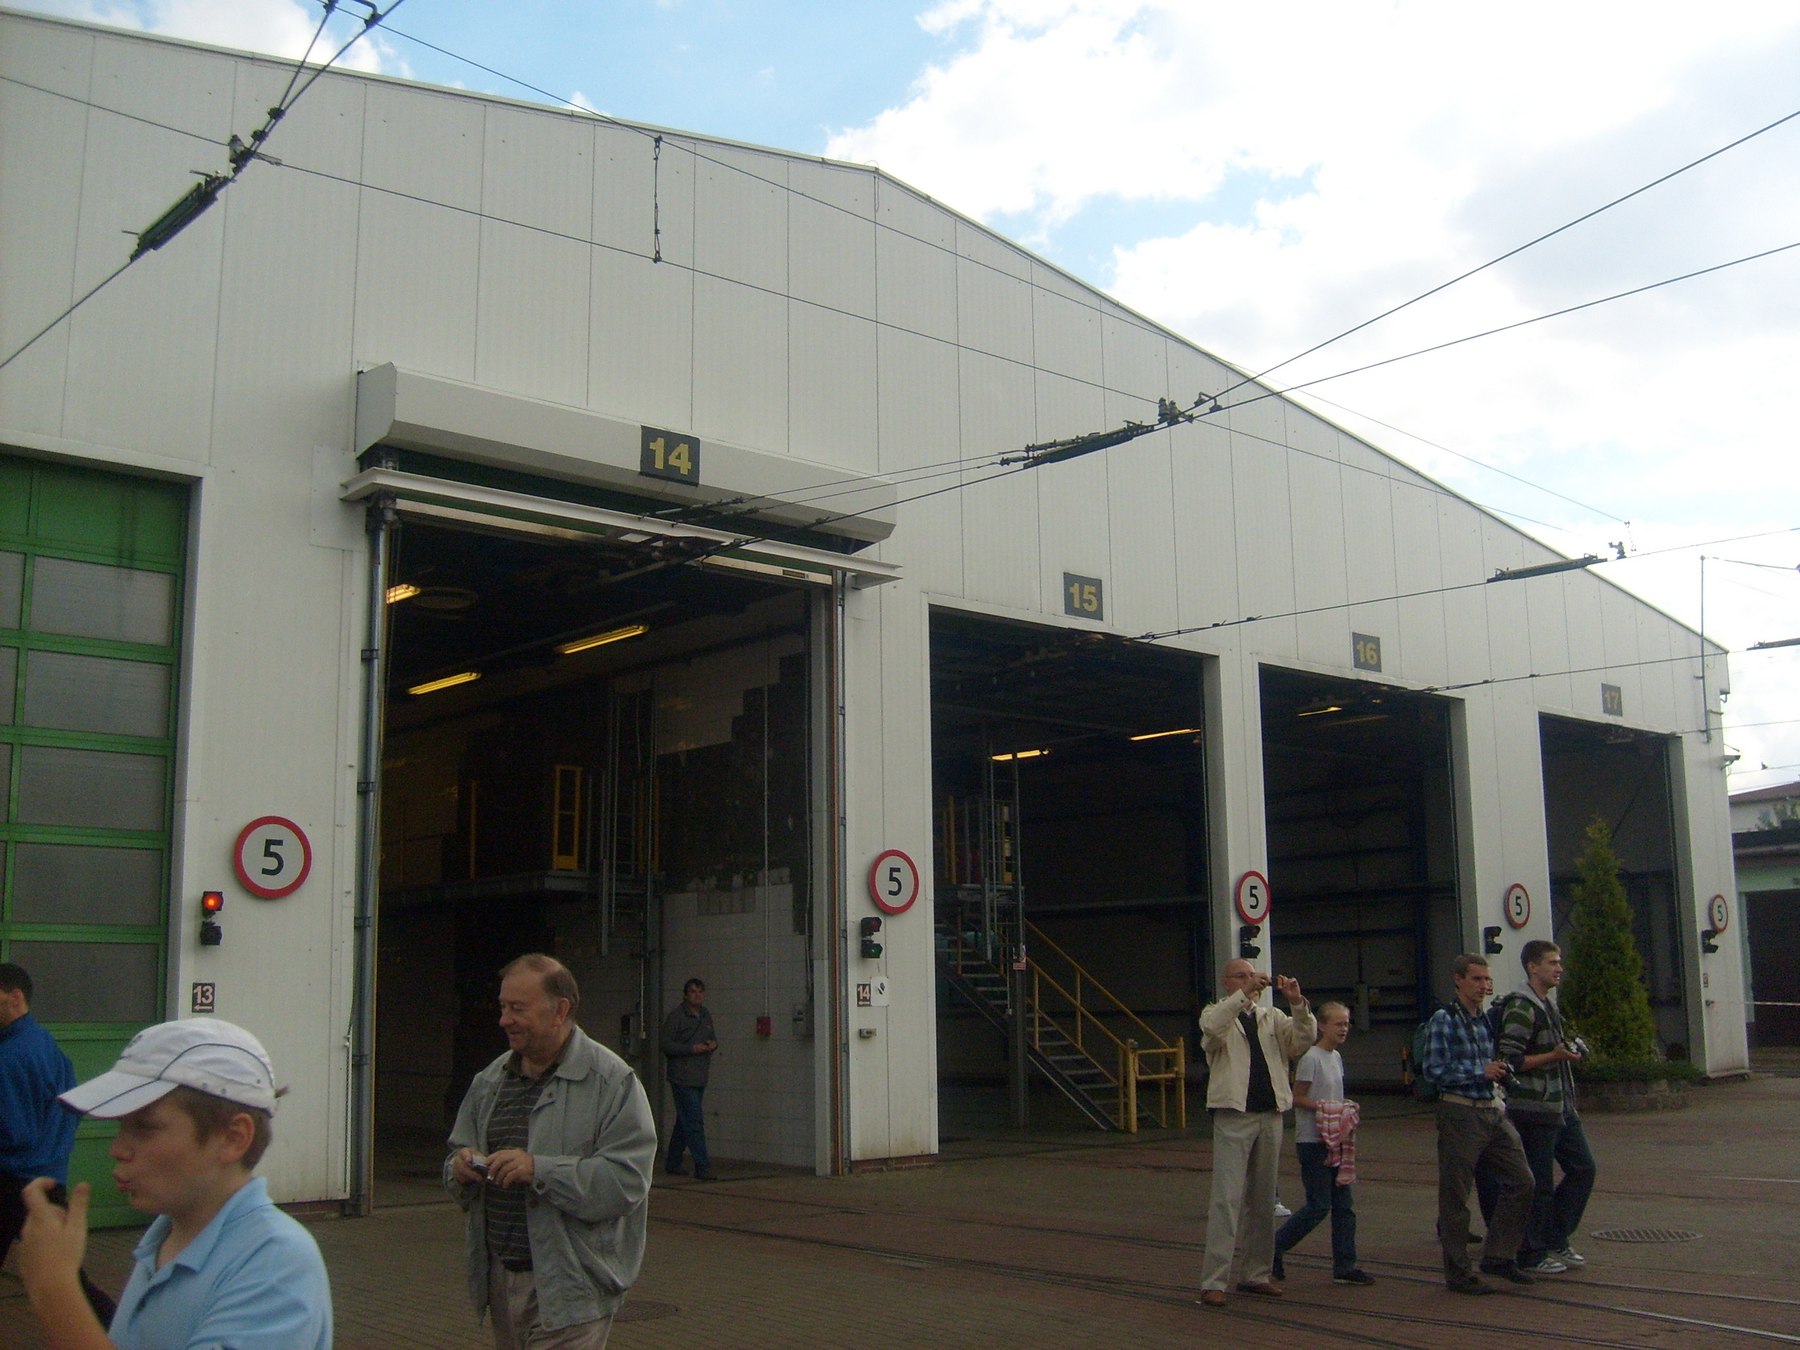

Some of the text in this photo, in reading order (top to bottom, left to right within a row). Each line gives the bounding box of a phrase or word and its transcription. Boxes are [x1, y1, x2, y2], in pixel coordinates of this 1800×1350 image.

[650, 438, 691, 475] 14
[1070, 583, 1098, 611] 15
[1357, 642, 1378, 665] 16
[1605, 691, 1620, 709] 17
[262, 839, 285, 876] 5
[888, 867, 902, 896] 5
[1250, 886, 1259, 910] 5
[1515, 896, 1522, 917] 5
[1717, 905, 1723, 921] 5
[194, 985, 213, 1004] 13
[858, 987, 870, 999] 14
